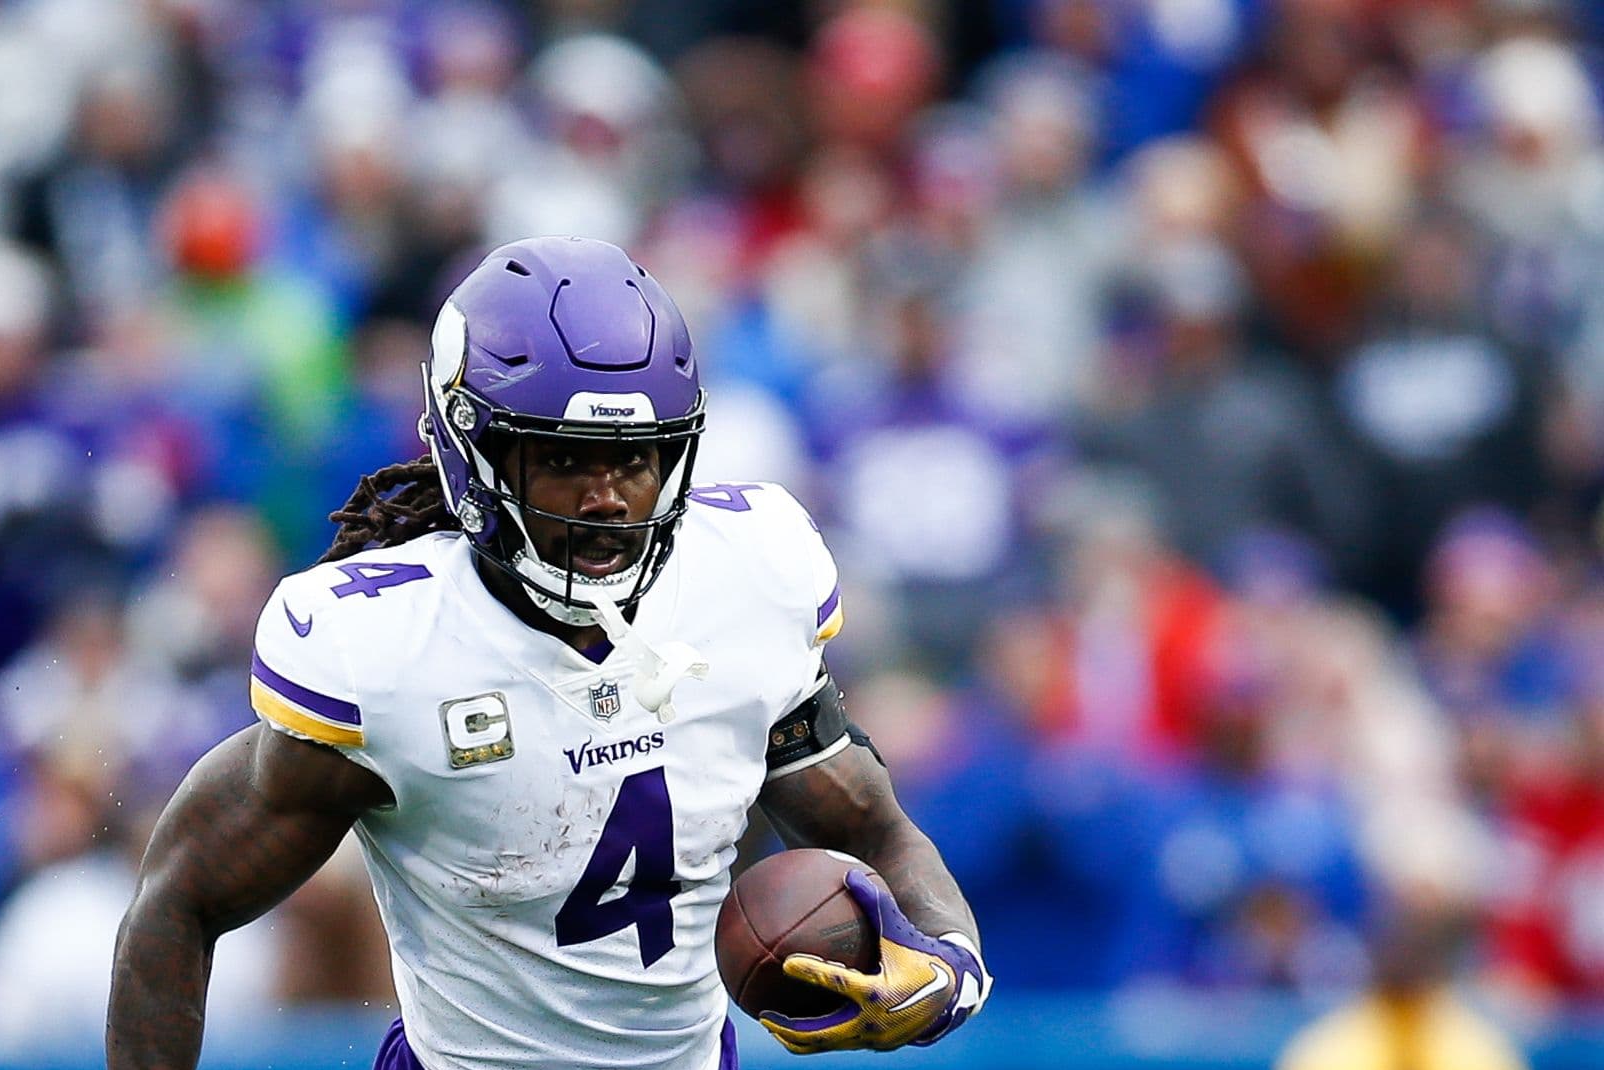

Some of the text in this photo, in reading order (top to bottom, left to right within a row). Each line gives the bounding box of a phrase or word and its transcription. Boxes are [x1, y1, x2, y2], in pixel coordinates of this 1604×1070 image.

[588, 403, 635, 417] VIKINGS
[330, 563, 434, 599] 4
[446, 697, 508, 750] C
[597, 697, 618, 715] NFL
[563, 731, 665, 775] VIKINGS
[554, 765, 683, 970] 4
